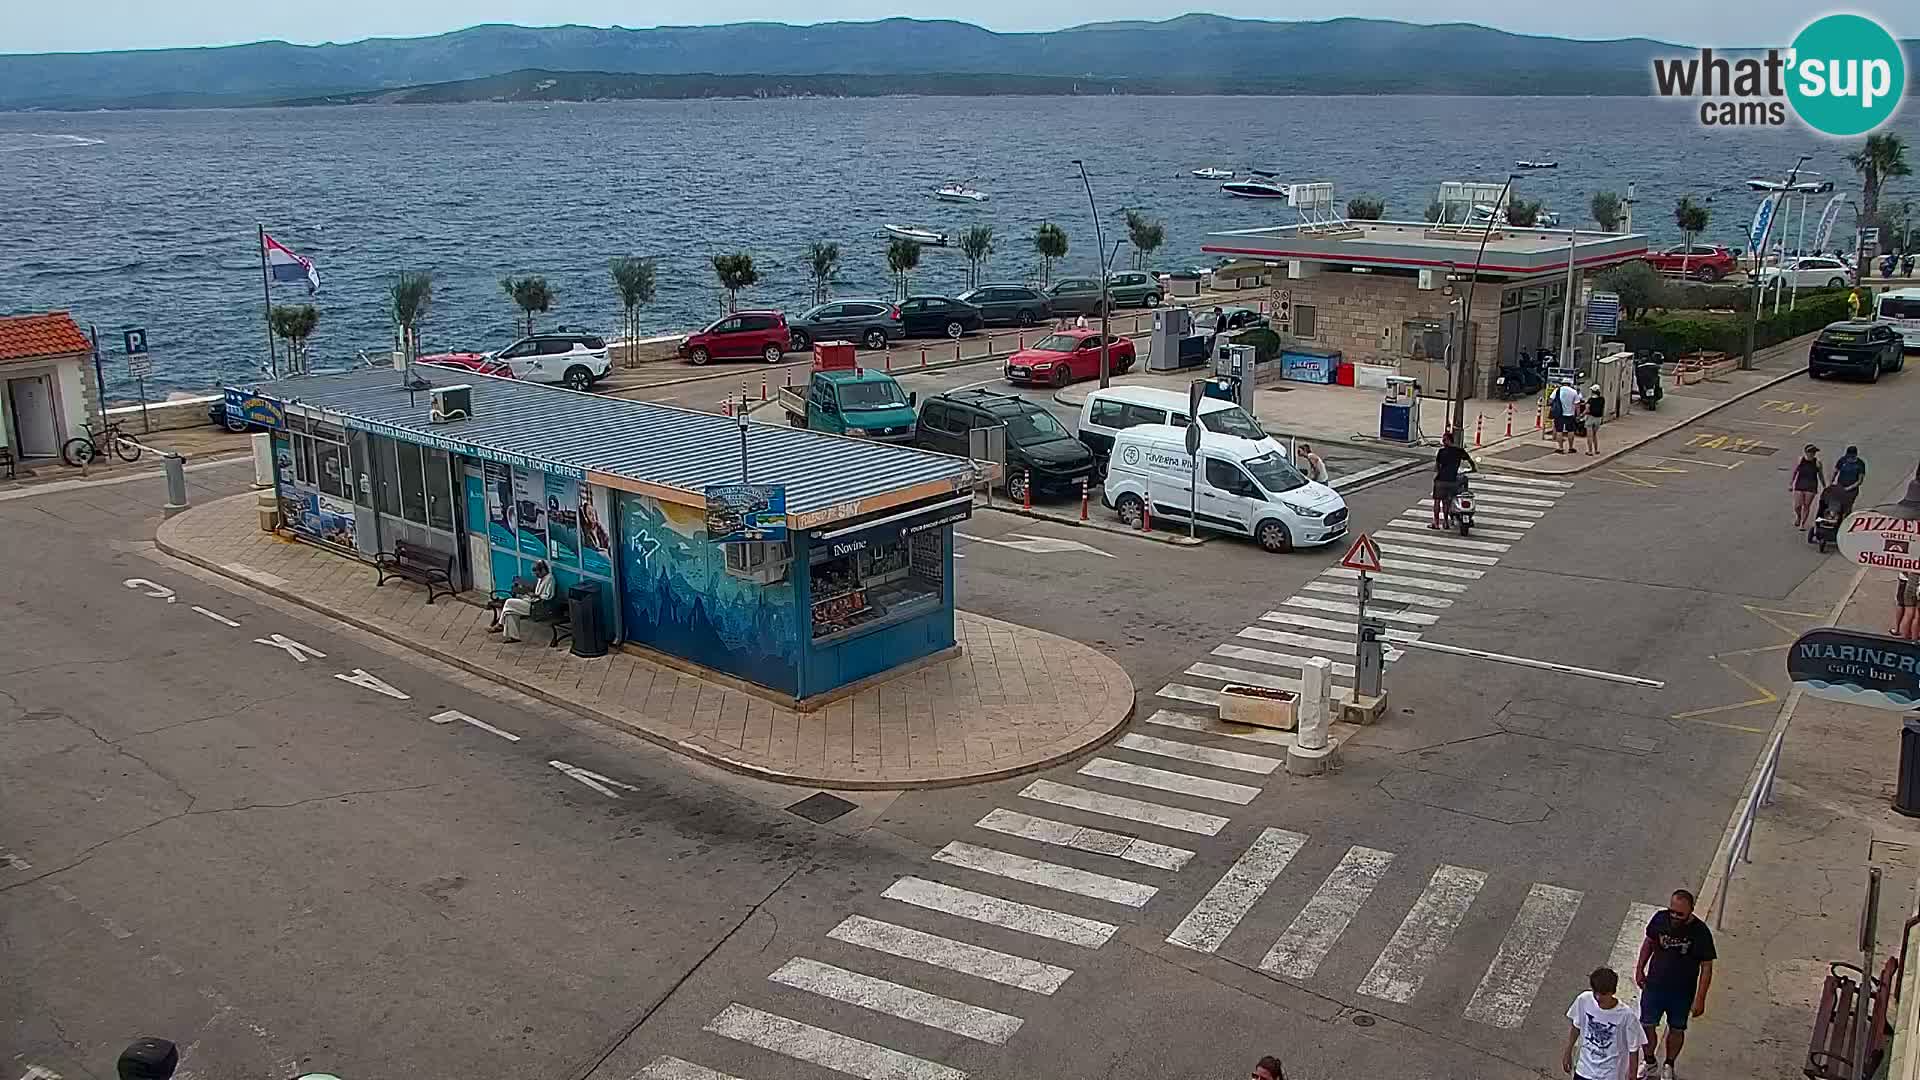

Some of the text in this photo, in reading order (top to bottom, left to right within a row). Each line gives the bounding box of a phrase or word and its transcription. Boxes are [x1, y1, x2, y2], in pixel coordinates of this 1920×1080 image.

[128, 332, 142, 352] P
[1758, 399, 1825, 416] TAXI
[1684, 432, 1765, 452] TAXI
[436, 438, 467, 454] POSTAJA
[477, 447, 493, 460] BUS
[494, 452, 526, 467] STATION
[527, 458, 554, 473] TICKET
[554, 465, 582, 479] OFFICE
[1848, 517, 1920, 535] PIZZE
[1880, 531, 1916, 543] GRILL
[1827, 663, 1897, 682] caffe bar
